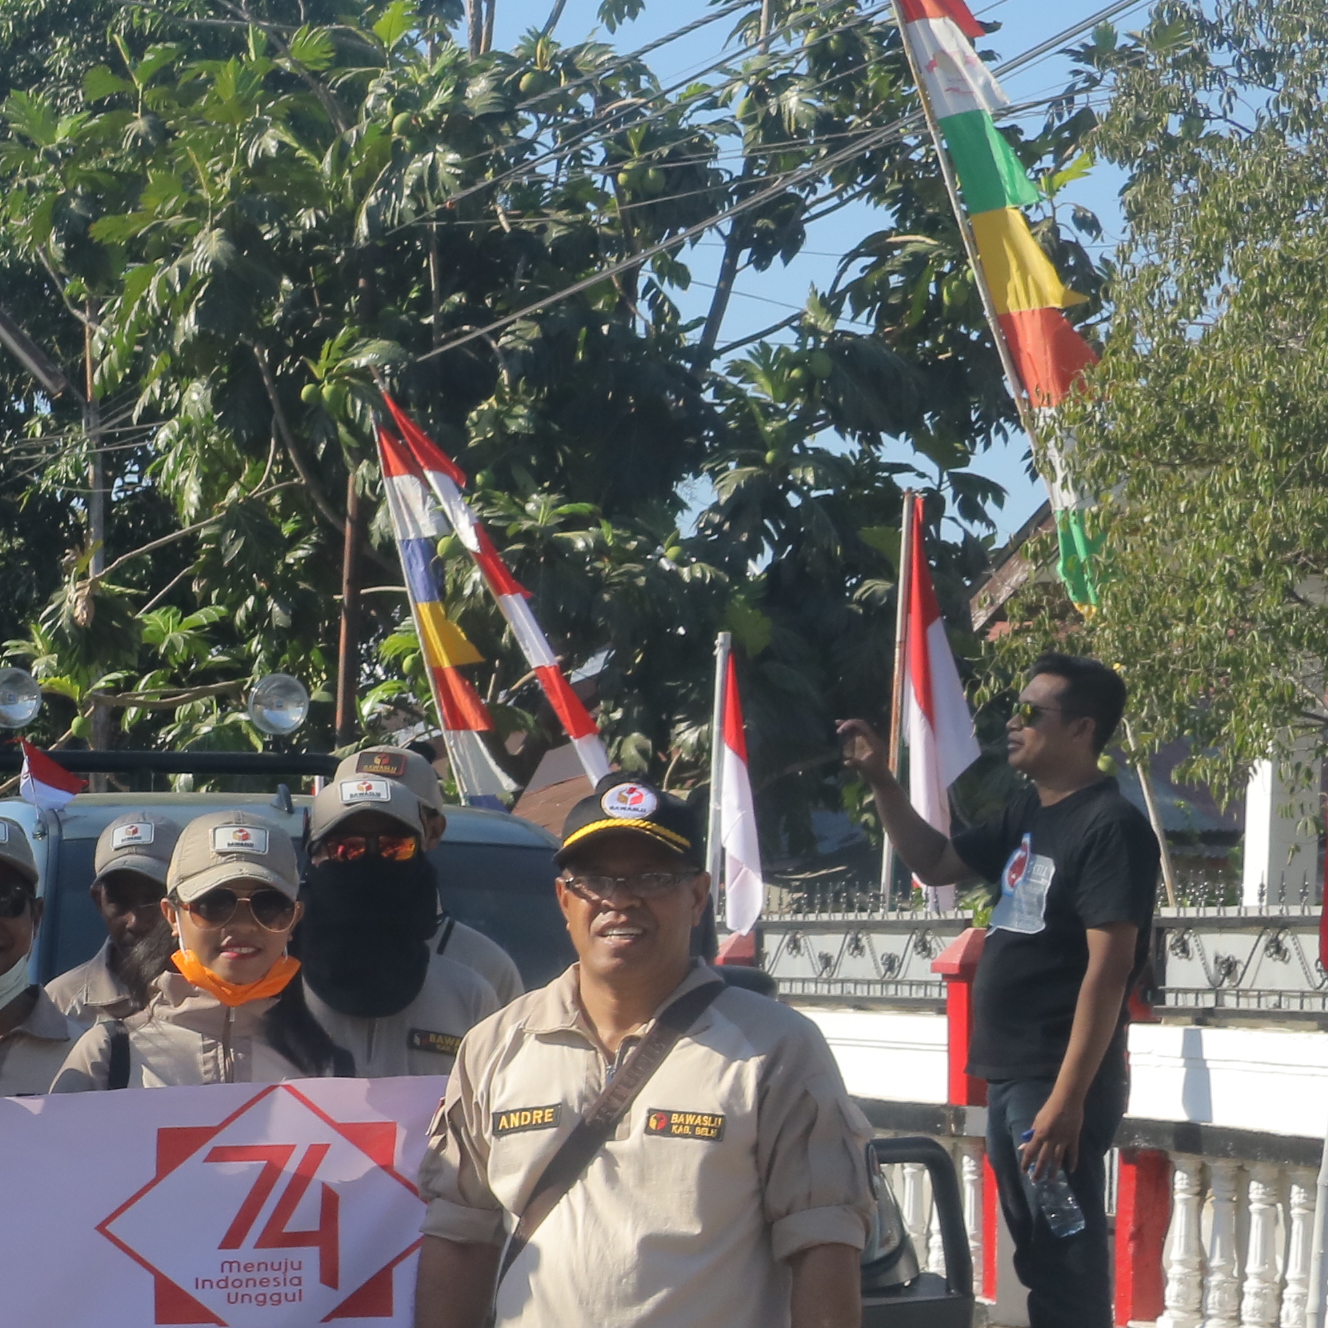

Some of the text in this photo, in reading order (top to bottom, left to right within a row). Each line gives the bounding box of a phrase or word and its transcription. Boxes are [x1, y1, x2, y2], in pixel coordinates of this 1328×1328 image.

[497, 1107, 555, 1131] ANDRE
[670, 1112, 722, 1128] BAWASLU
[202, 1142, 341, 1291] 74
[195, 1274, 303, 1290] Indonesia
[226, 1289, 303, 1307] Unggul
